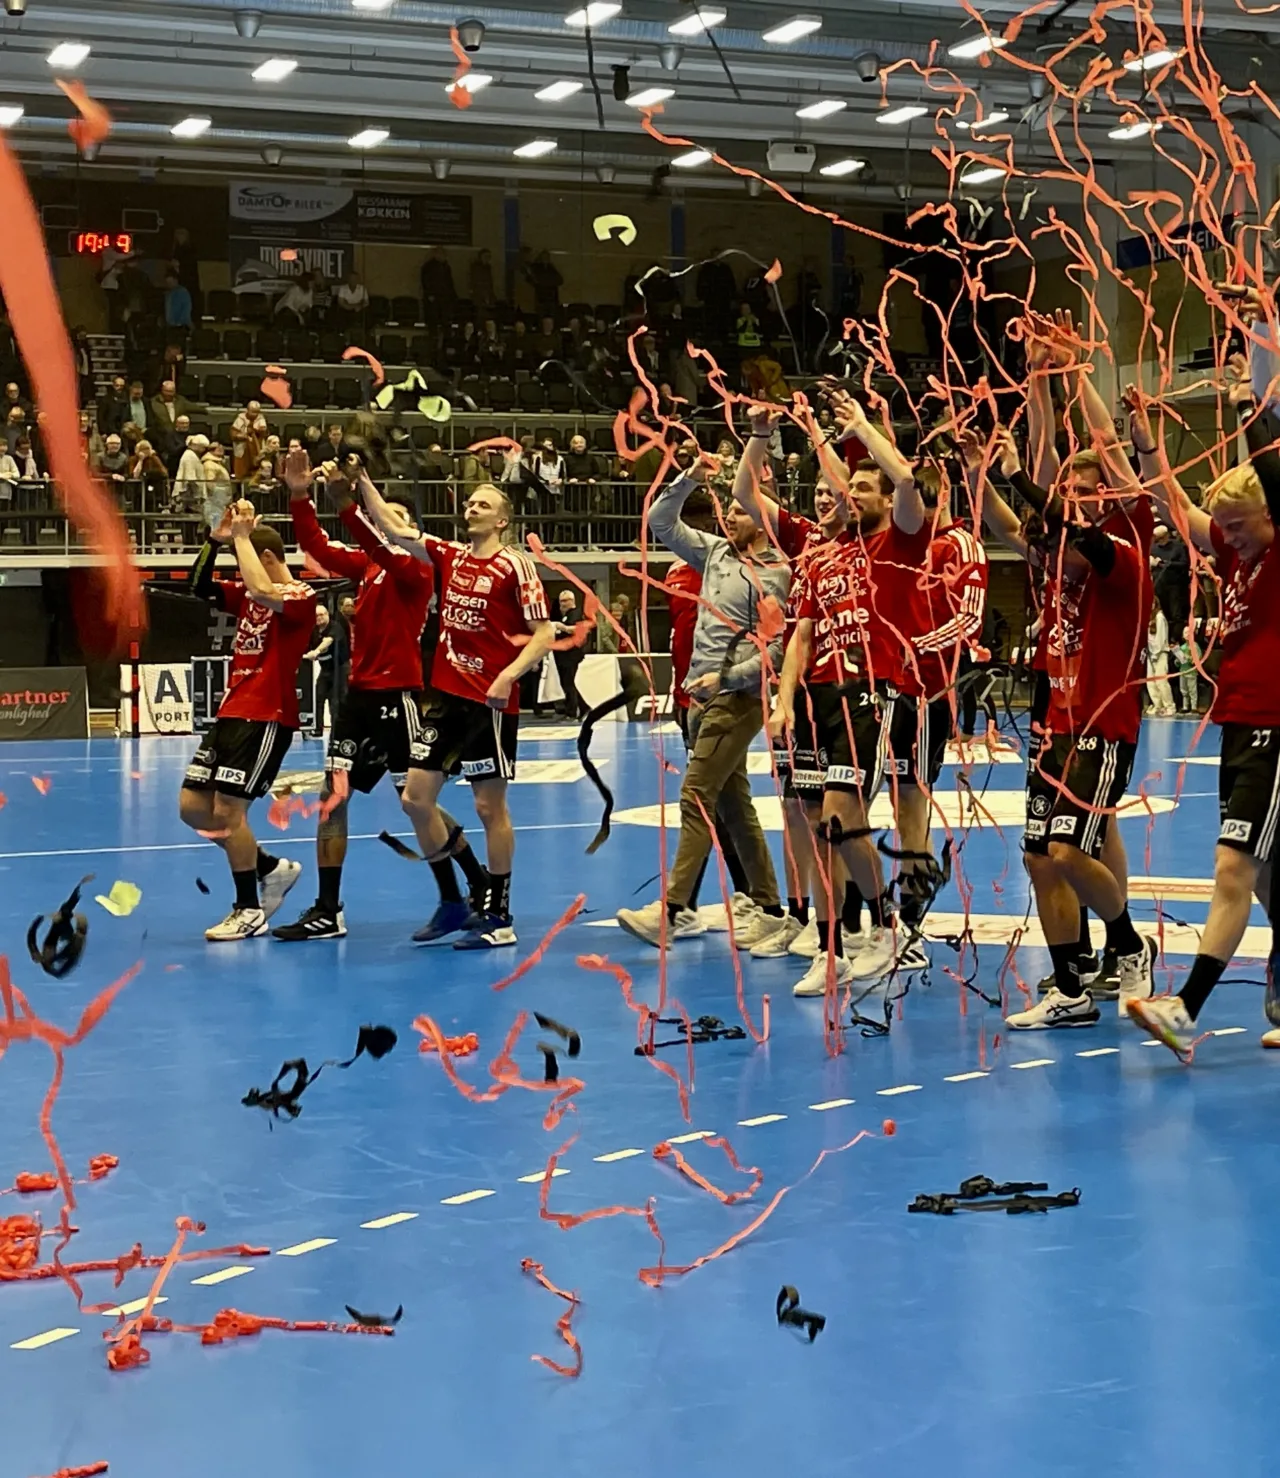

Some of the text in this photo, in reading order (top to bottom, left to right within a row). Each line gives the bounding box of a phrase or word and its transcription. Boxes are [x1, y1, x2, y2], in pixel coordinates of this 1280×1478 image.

[357, 207, 411, 220] KØKKEN
[380, 705, 399, 720] 24
[1251, 729, 1272, 748] 27
